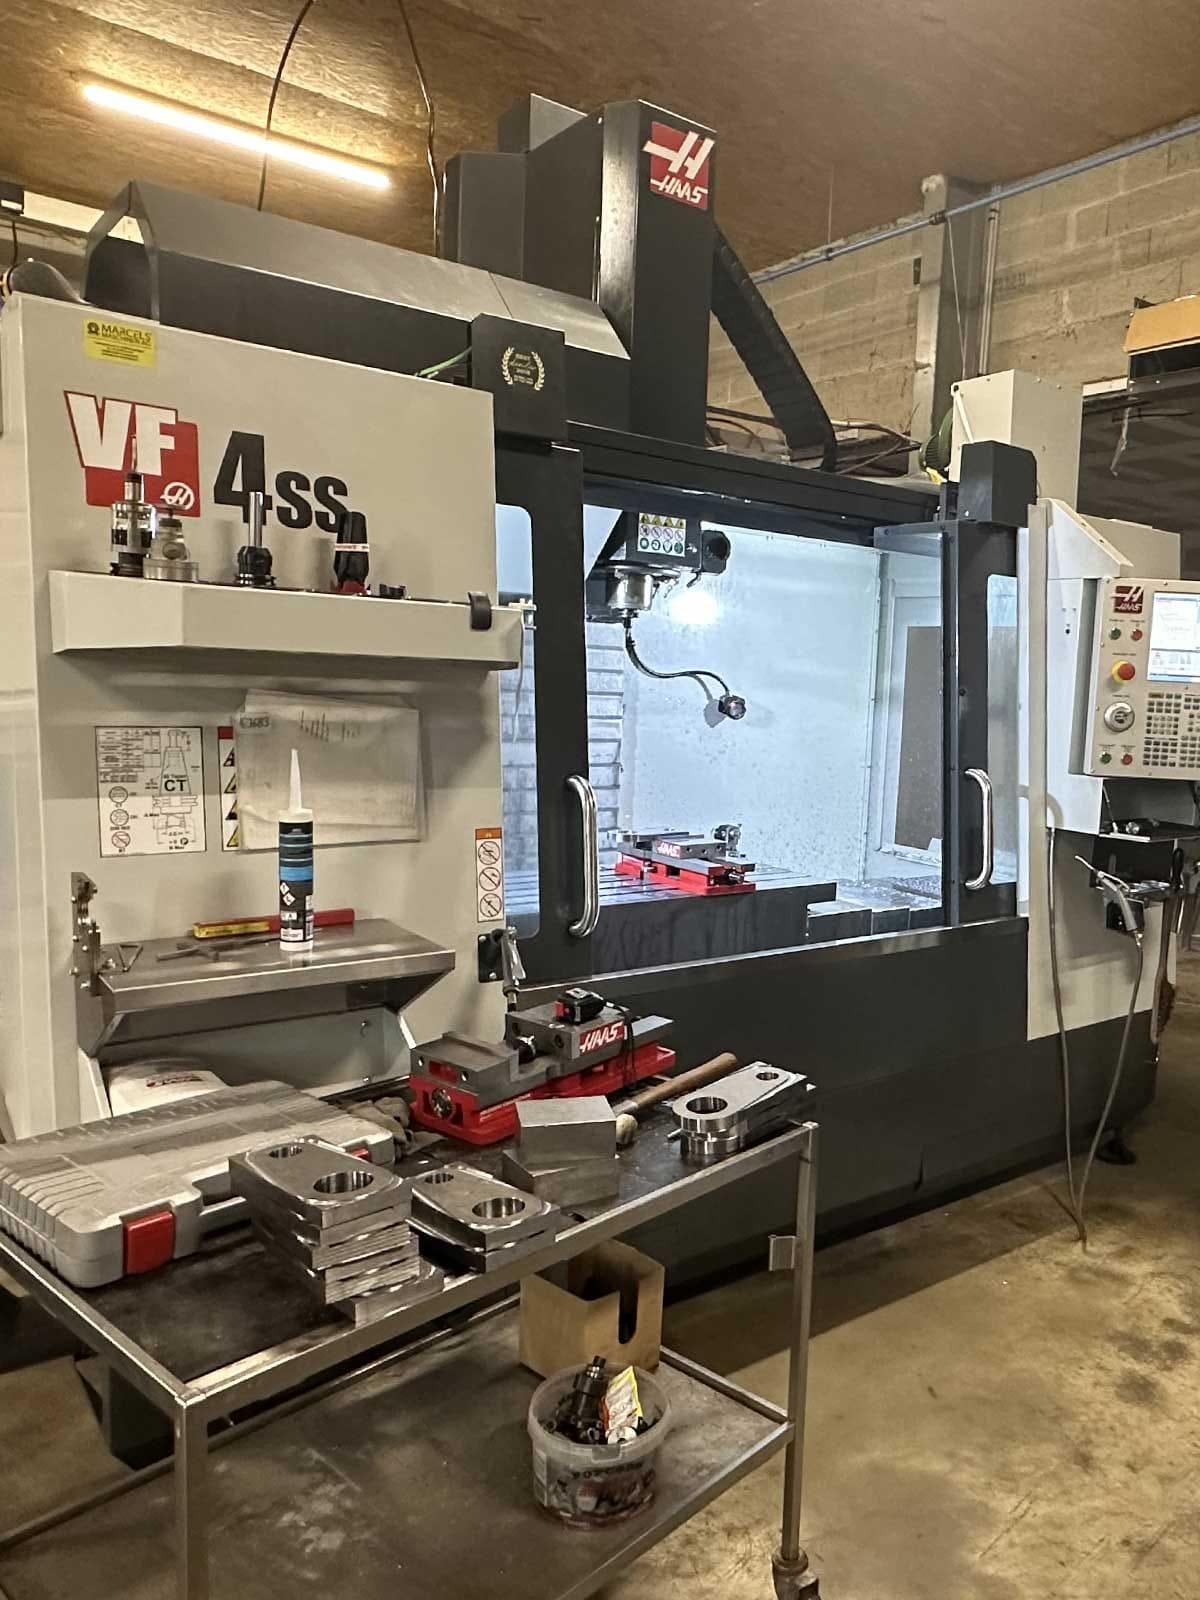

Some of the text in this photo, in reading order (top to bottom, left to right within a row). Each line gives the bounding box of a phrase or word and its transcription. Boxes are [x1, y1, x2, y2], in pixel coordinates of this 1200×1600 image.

[650, 175, 708, 204] HAAS
[101, 324, 152, 342] MARCELS
[66, 391, 177, 476] VF
[164, 779, 187, 792] CT
[580, 1020, 624, 1053] HAAS
